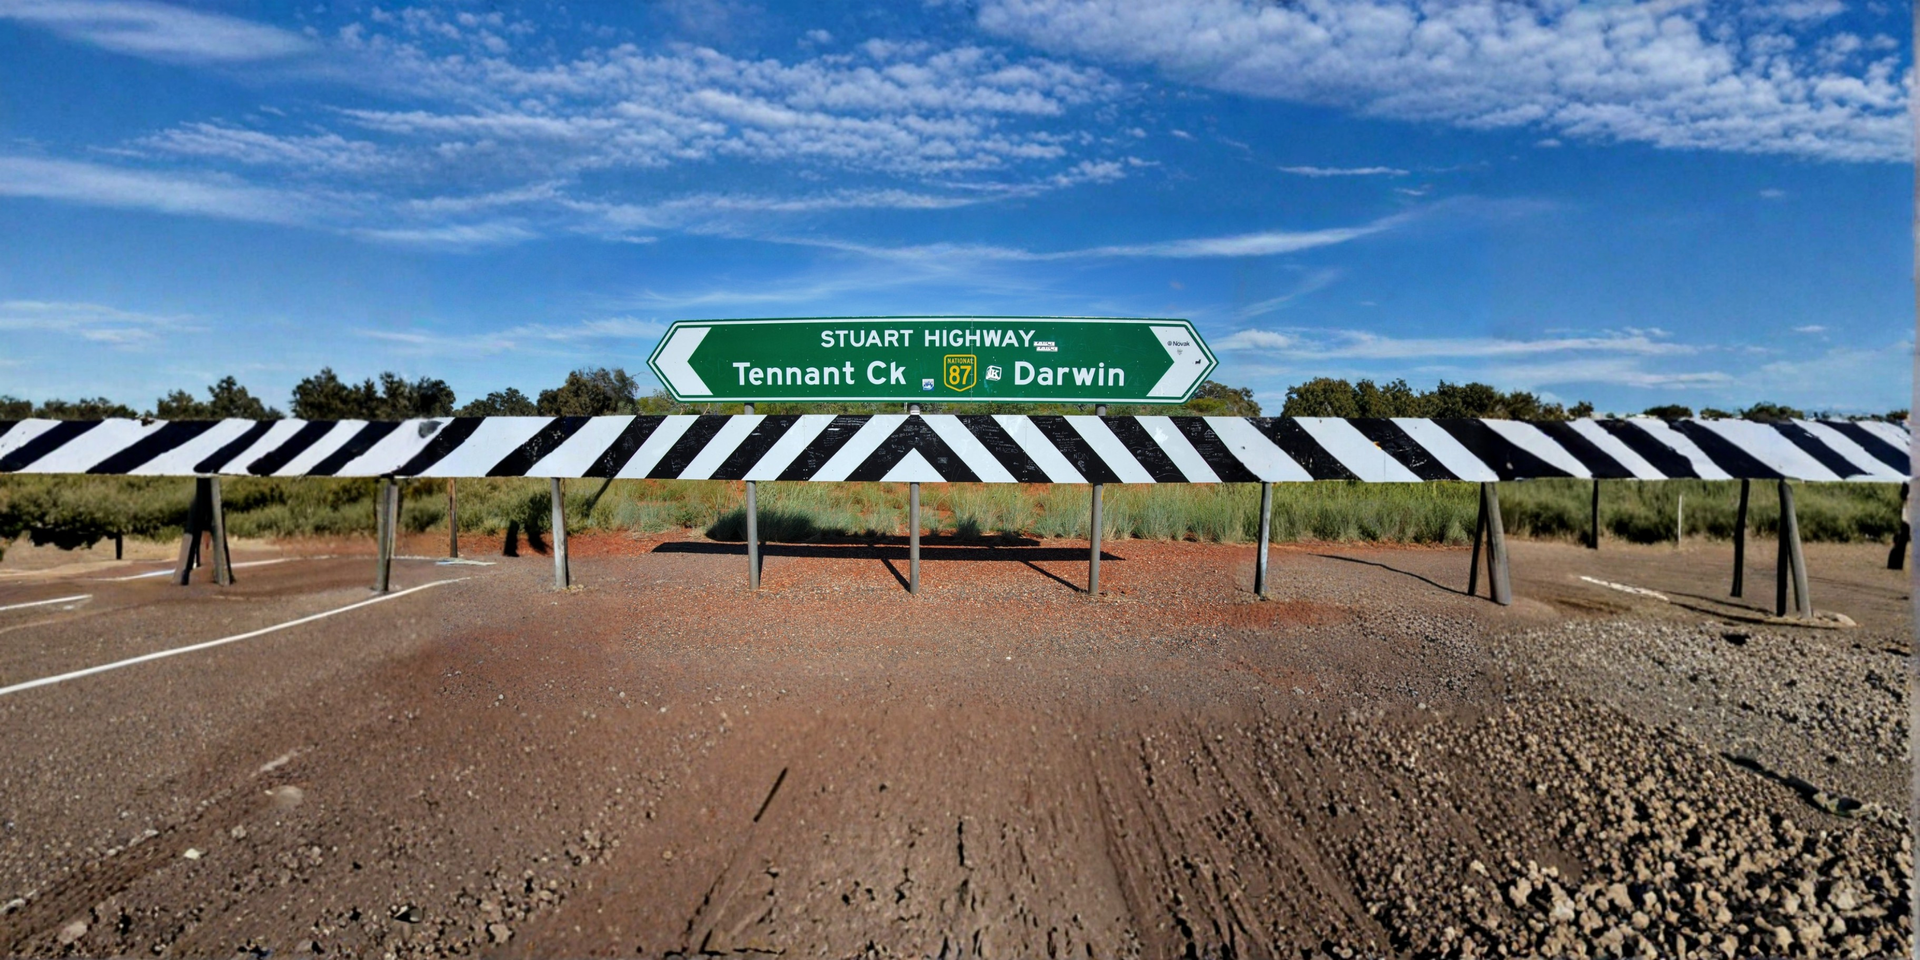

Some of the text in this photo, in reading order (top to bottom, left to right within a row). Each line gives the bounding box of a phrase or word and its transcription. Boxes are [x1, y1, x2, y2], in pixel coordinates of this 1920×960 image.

[821, 329, 1036, 347] STUART HIGHWAY
[733, 361, 855, 386] Tennant
[867, 361, 907, 385] Ck
[949, 365, 972, 385] 87
[1014, 361, 1125, 386] Darwin
